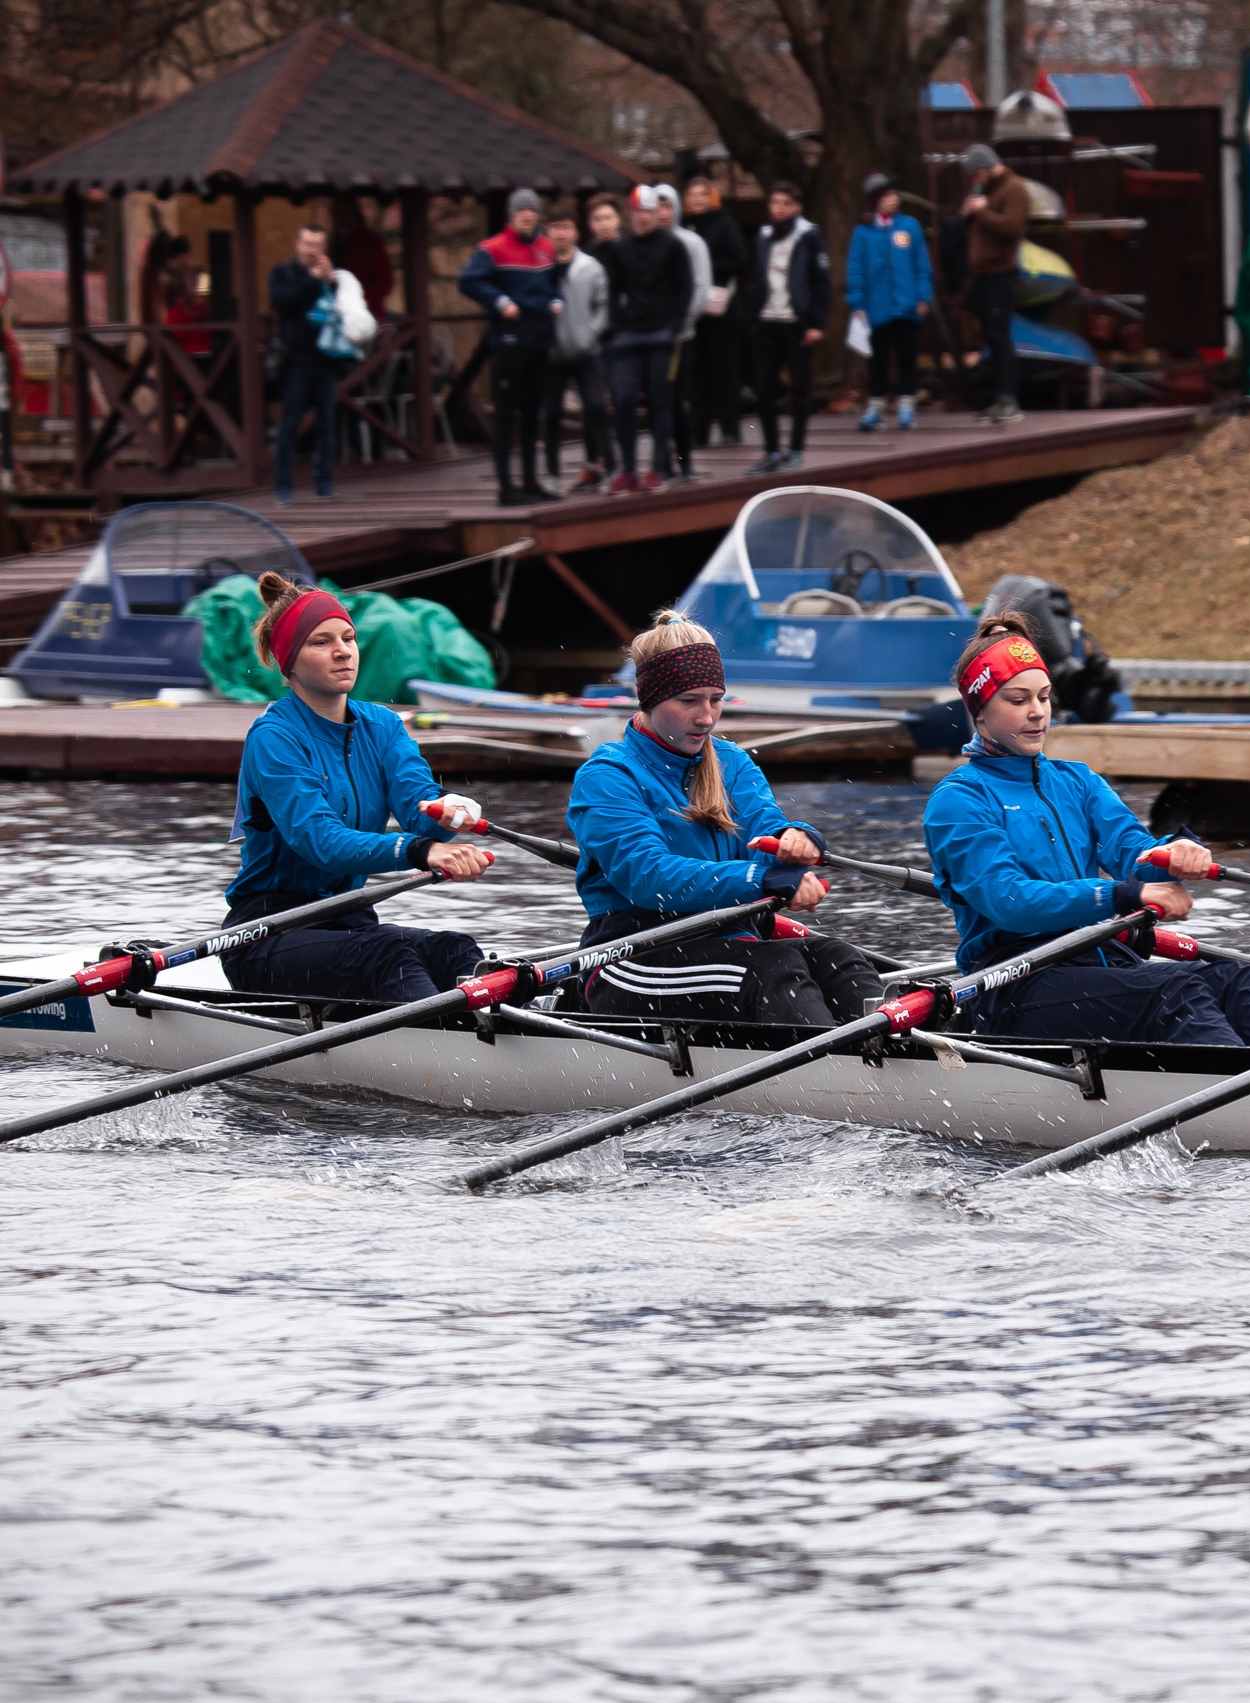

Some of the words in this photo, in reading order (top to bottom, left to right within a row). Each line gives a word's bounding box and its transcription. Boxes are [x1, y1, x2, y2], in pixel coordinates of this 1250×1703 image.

[205, 923, 268, 955] WinTech
[578, 941, 634, 972] WinTech
[982, 959, 1031, 992] WinTech
